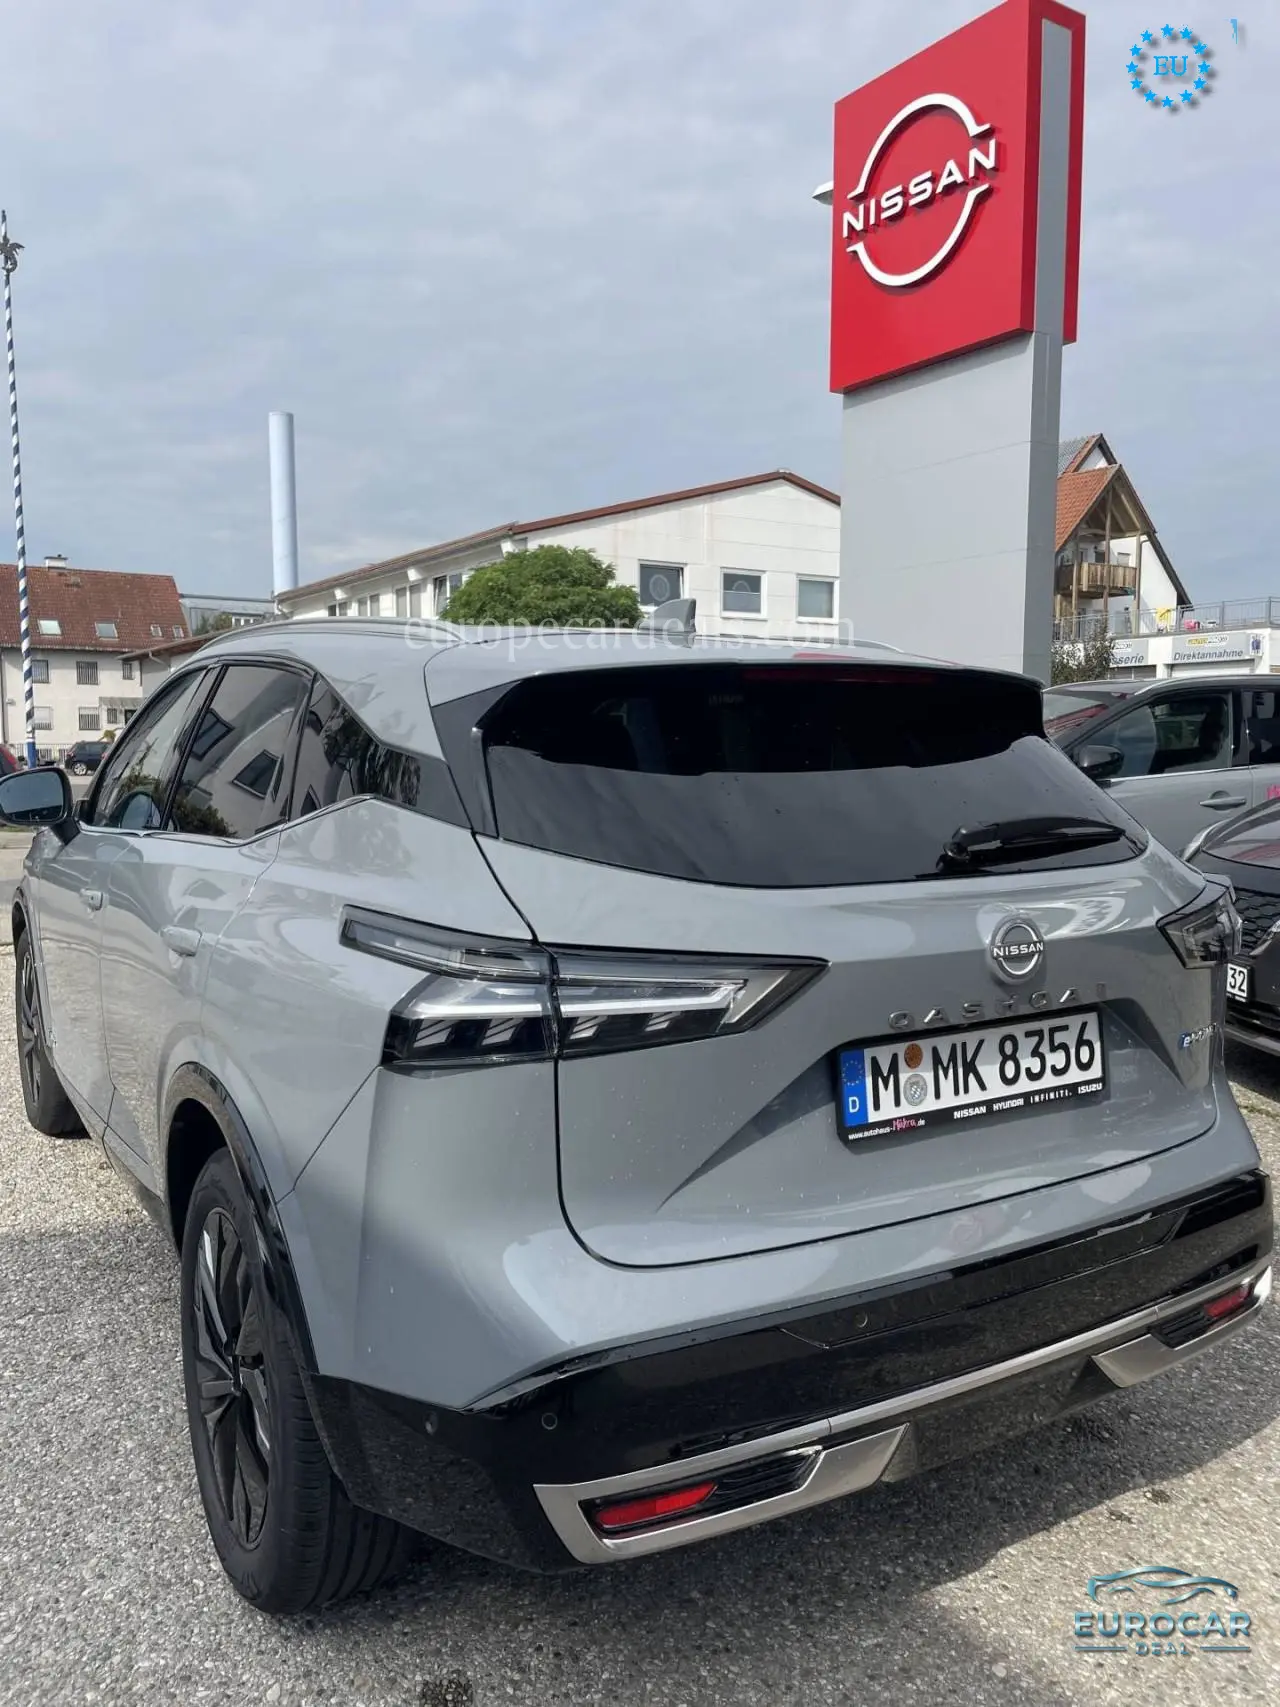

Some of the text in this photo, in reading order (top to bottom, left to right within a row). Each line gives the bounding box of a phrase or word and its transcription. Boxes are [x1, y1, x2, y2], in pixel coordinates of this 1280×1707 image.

[842, 139, 997, 239] NISSAN
[1173, 648, 1244, 662] Direktannahme
[993, 941, 1044, 958] NISSAN
[1229, 966, 1246, 993] 32
[870, 1021, 1096, 1112] M MK 8356
[848, 1096, 860, 1113] D
[953, 1105, 987, 1120] NISSAN
[993, 1098, 1025, 1111] HYUNDAI
[1077, 1082, 1103, 1095] ISUZU
